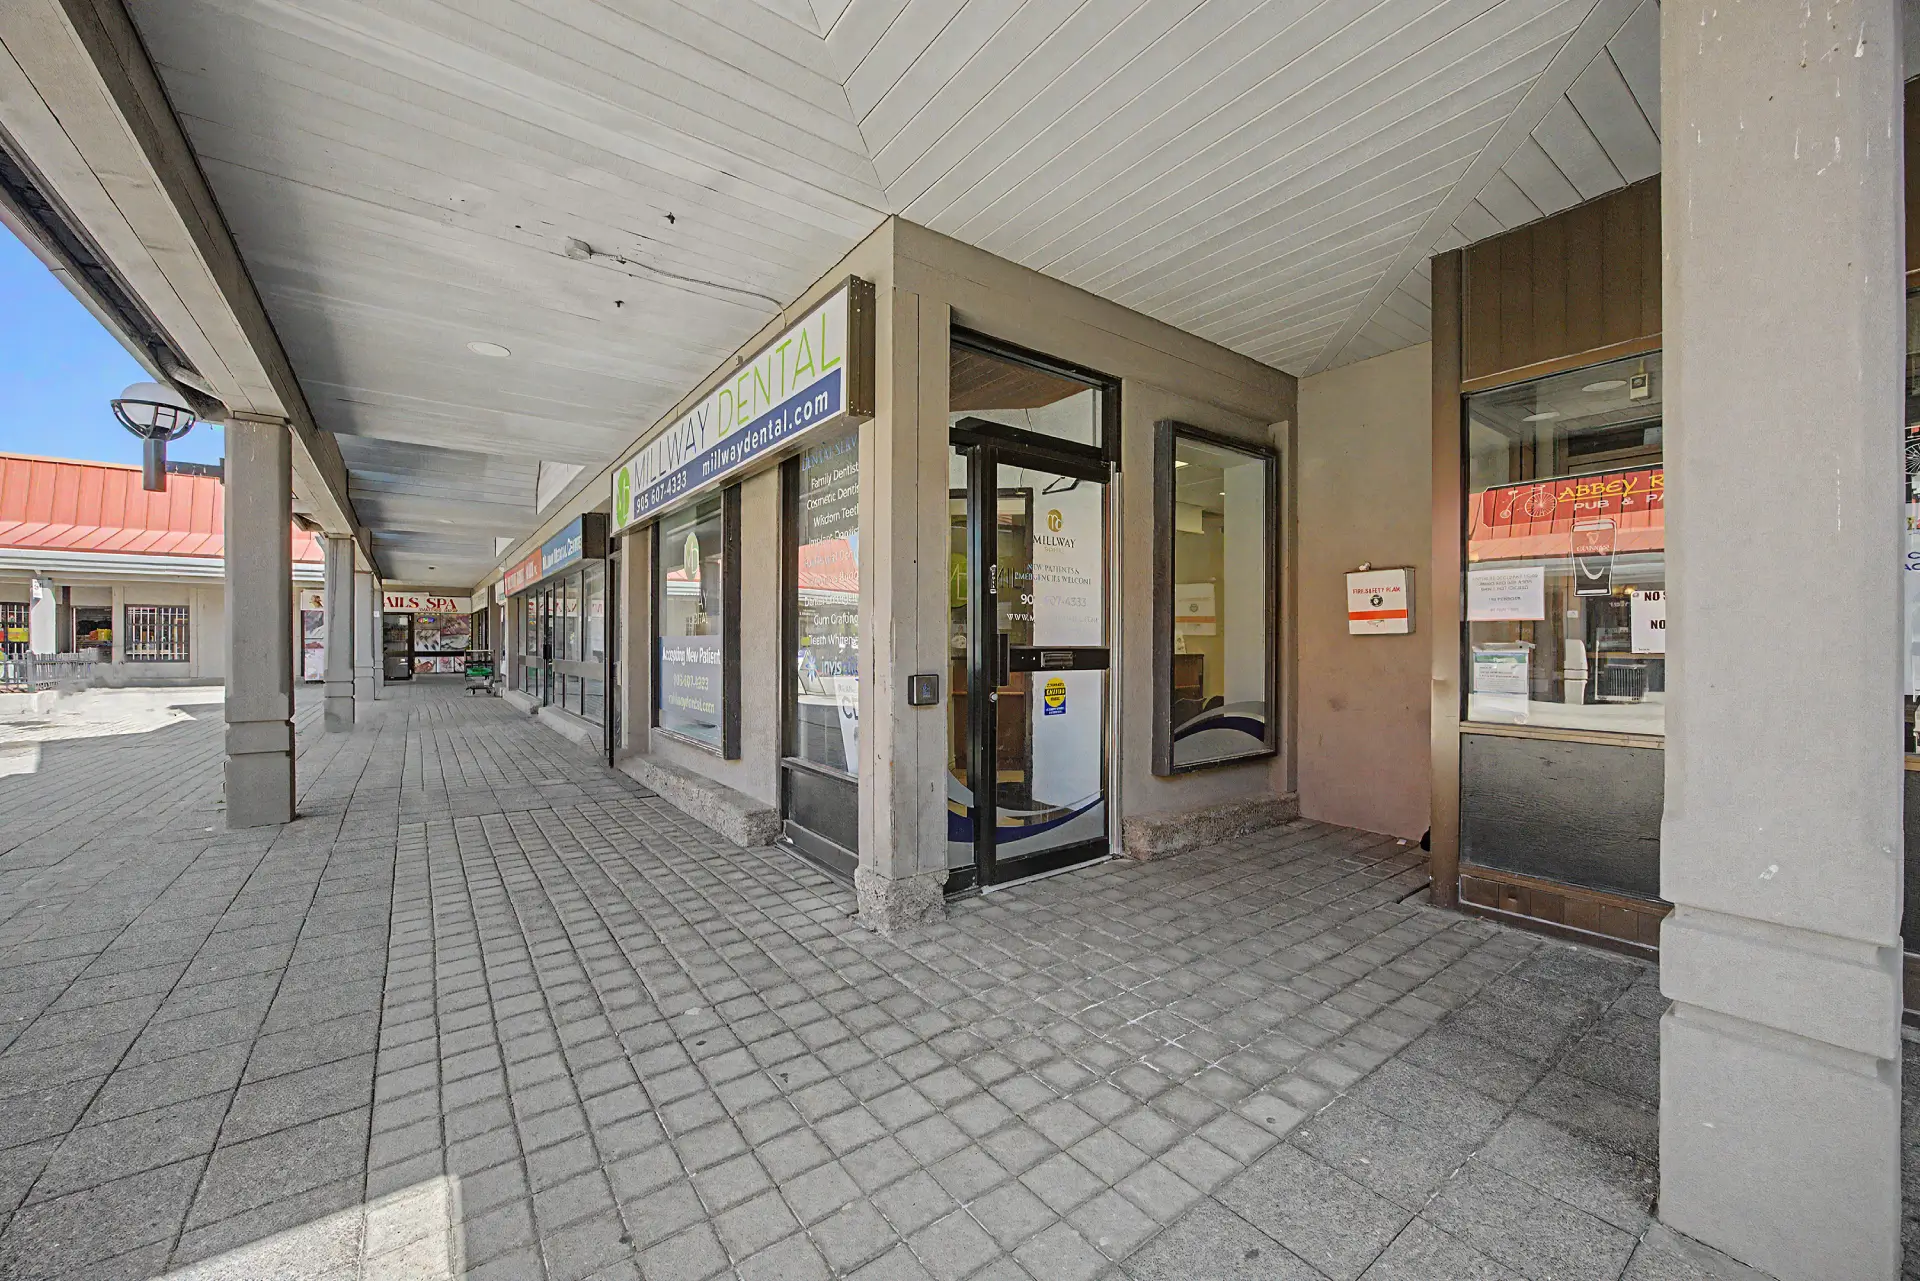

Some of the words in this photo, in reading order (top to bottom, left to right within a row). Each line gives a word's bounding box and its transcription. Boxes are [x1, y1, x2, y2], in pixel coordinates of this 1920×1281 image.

[634, 402, 710, 491] MILLWAY
[718, 312, 841, 438] DENTAL
[636, 496, 650, 514] 905
[651, 470, 688, 506] 607-4333
[702, 390, 829, 477] millwaydental.com
[811, 474, 832, 490] Family
[1557, 477, 1638, 500] ABBEY
[806, 490, 836, 510] Cosmetic
[1574, 500, 1610, 511] PUB
[1621, 497, 1635, 506] &
[813, 509, 841, 528] Wisdom
[1033, 534, 1076, 549] MILLWAY
[426, 598, 457, 610] SPA
[1644, 591, 1660, 602] NO
[813, 614, 830, 627] Gum
[1651, 619, 1666, 630] NO
[808, 634, 827, 646] Teeth
[662, 646, 686, 666] Accepting
[686, 646, 698, 663] New
